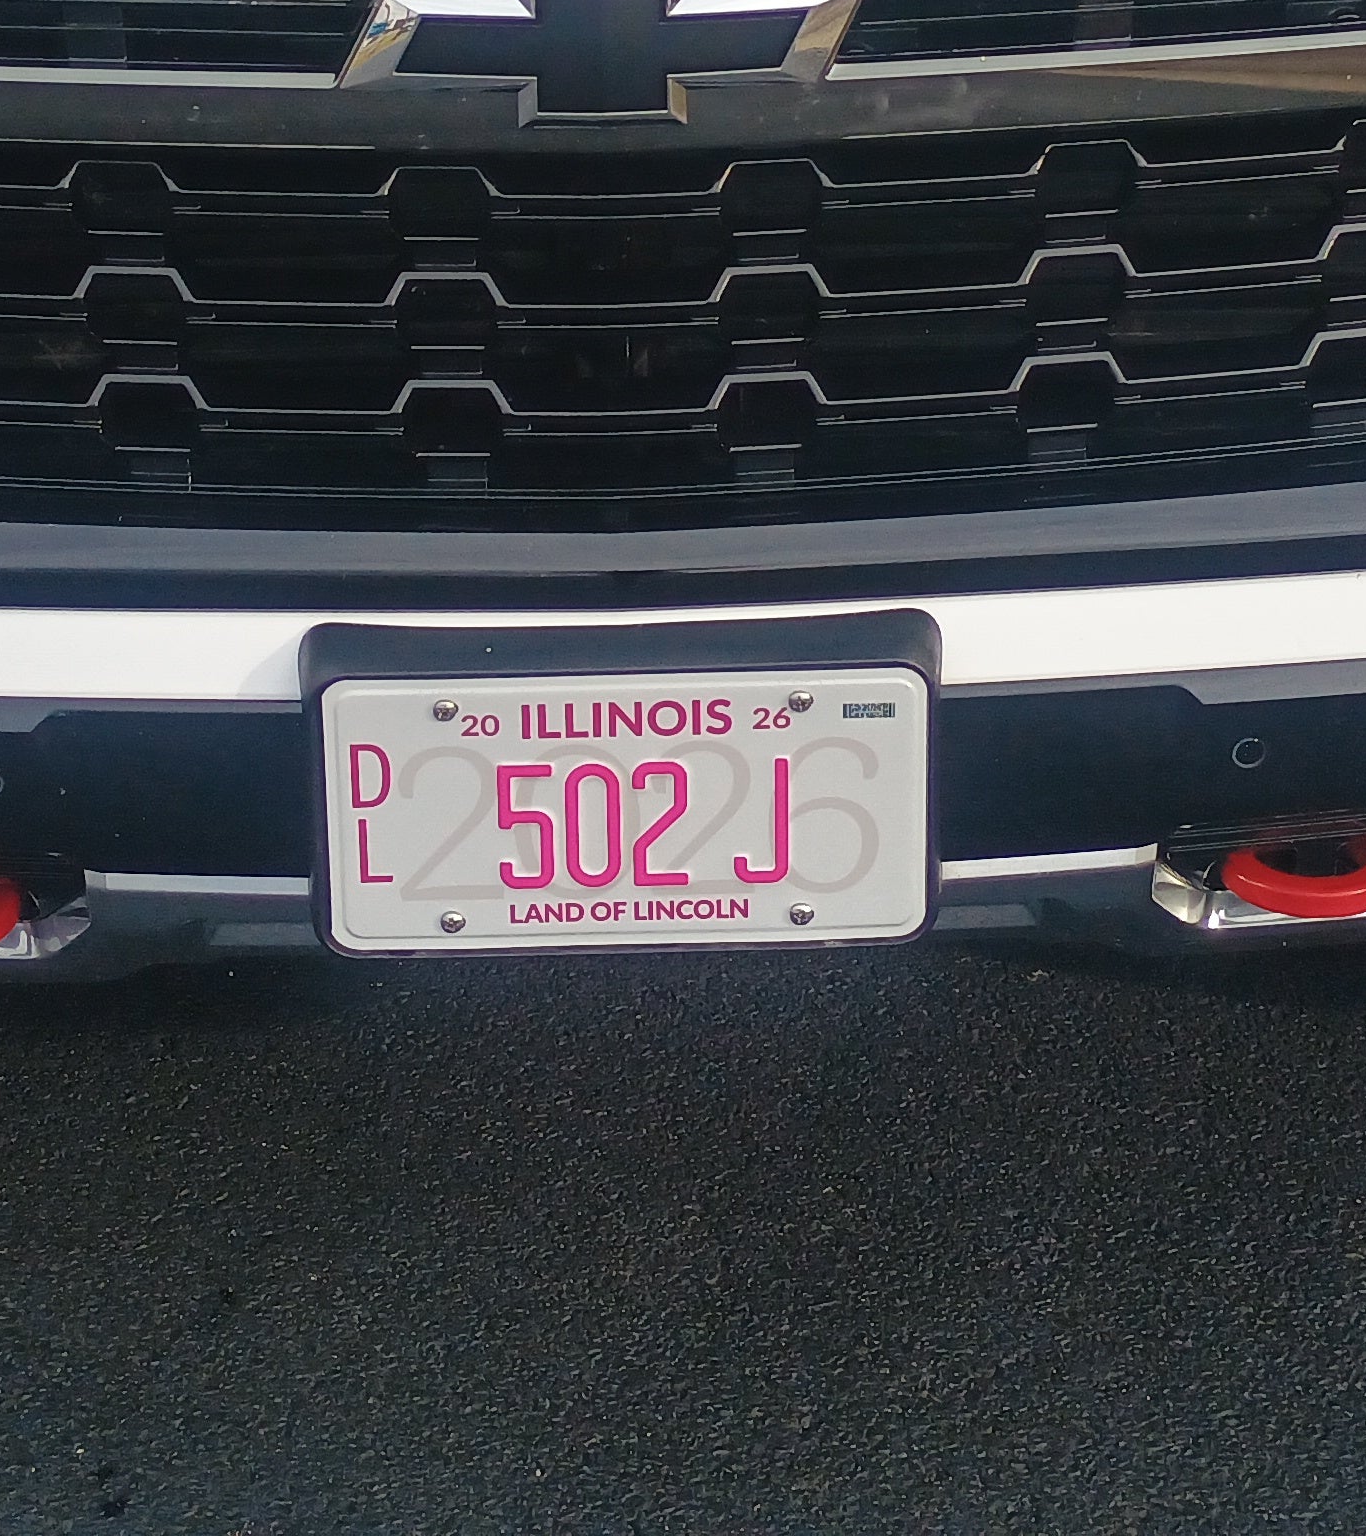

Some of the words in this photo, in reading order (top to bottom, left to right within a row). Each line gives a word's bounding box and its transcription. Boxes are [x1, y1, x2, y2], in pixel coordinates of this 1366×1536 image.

[461, 714, 502, 737] 20
[520, 698, 734, 740] ILLINOIS
[752, 707, 792, 730] 26
[494, 759, 691, 892] 502
[732, 756, 791, 886] J
[509, 903, 586, 925] LAND
[589, 901, 627, 923] OF
[633, 898, 750, 922] LINCOLN
